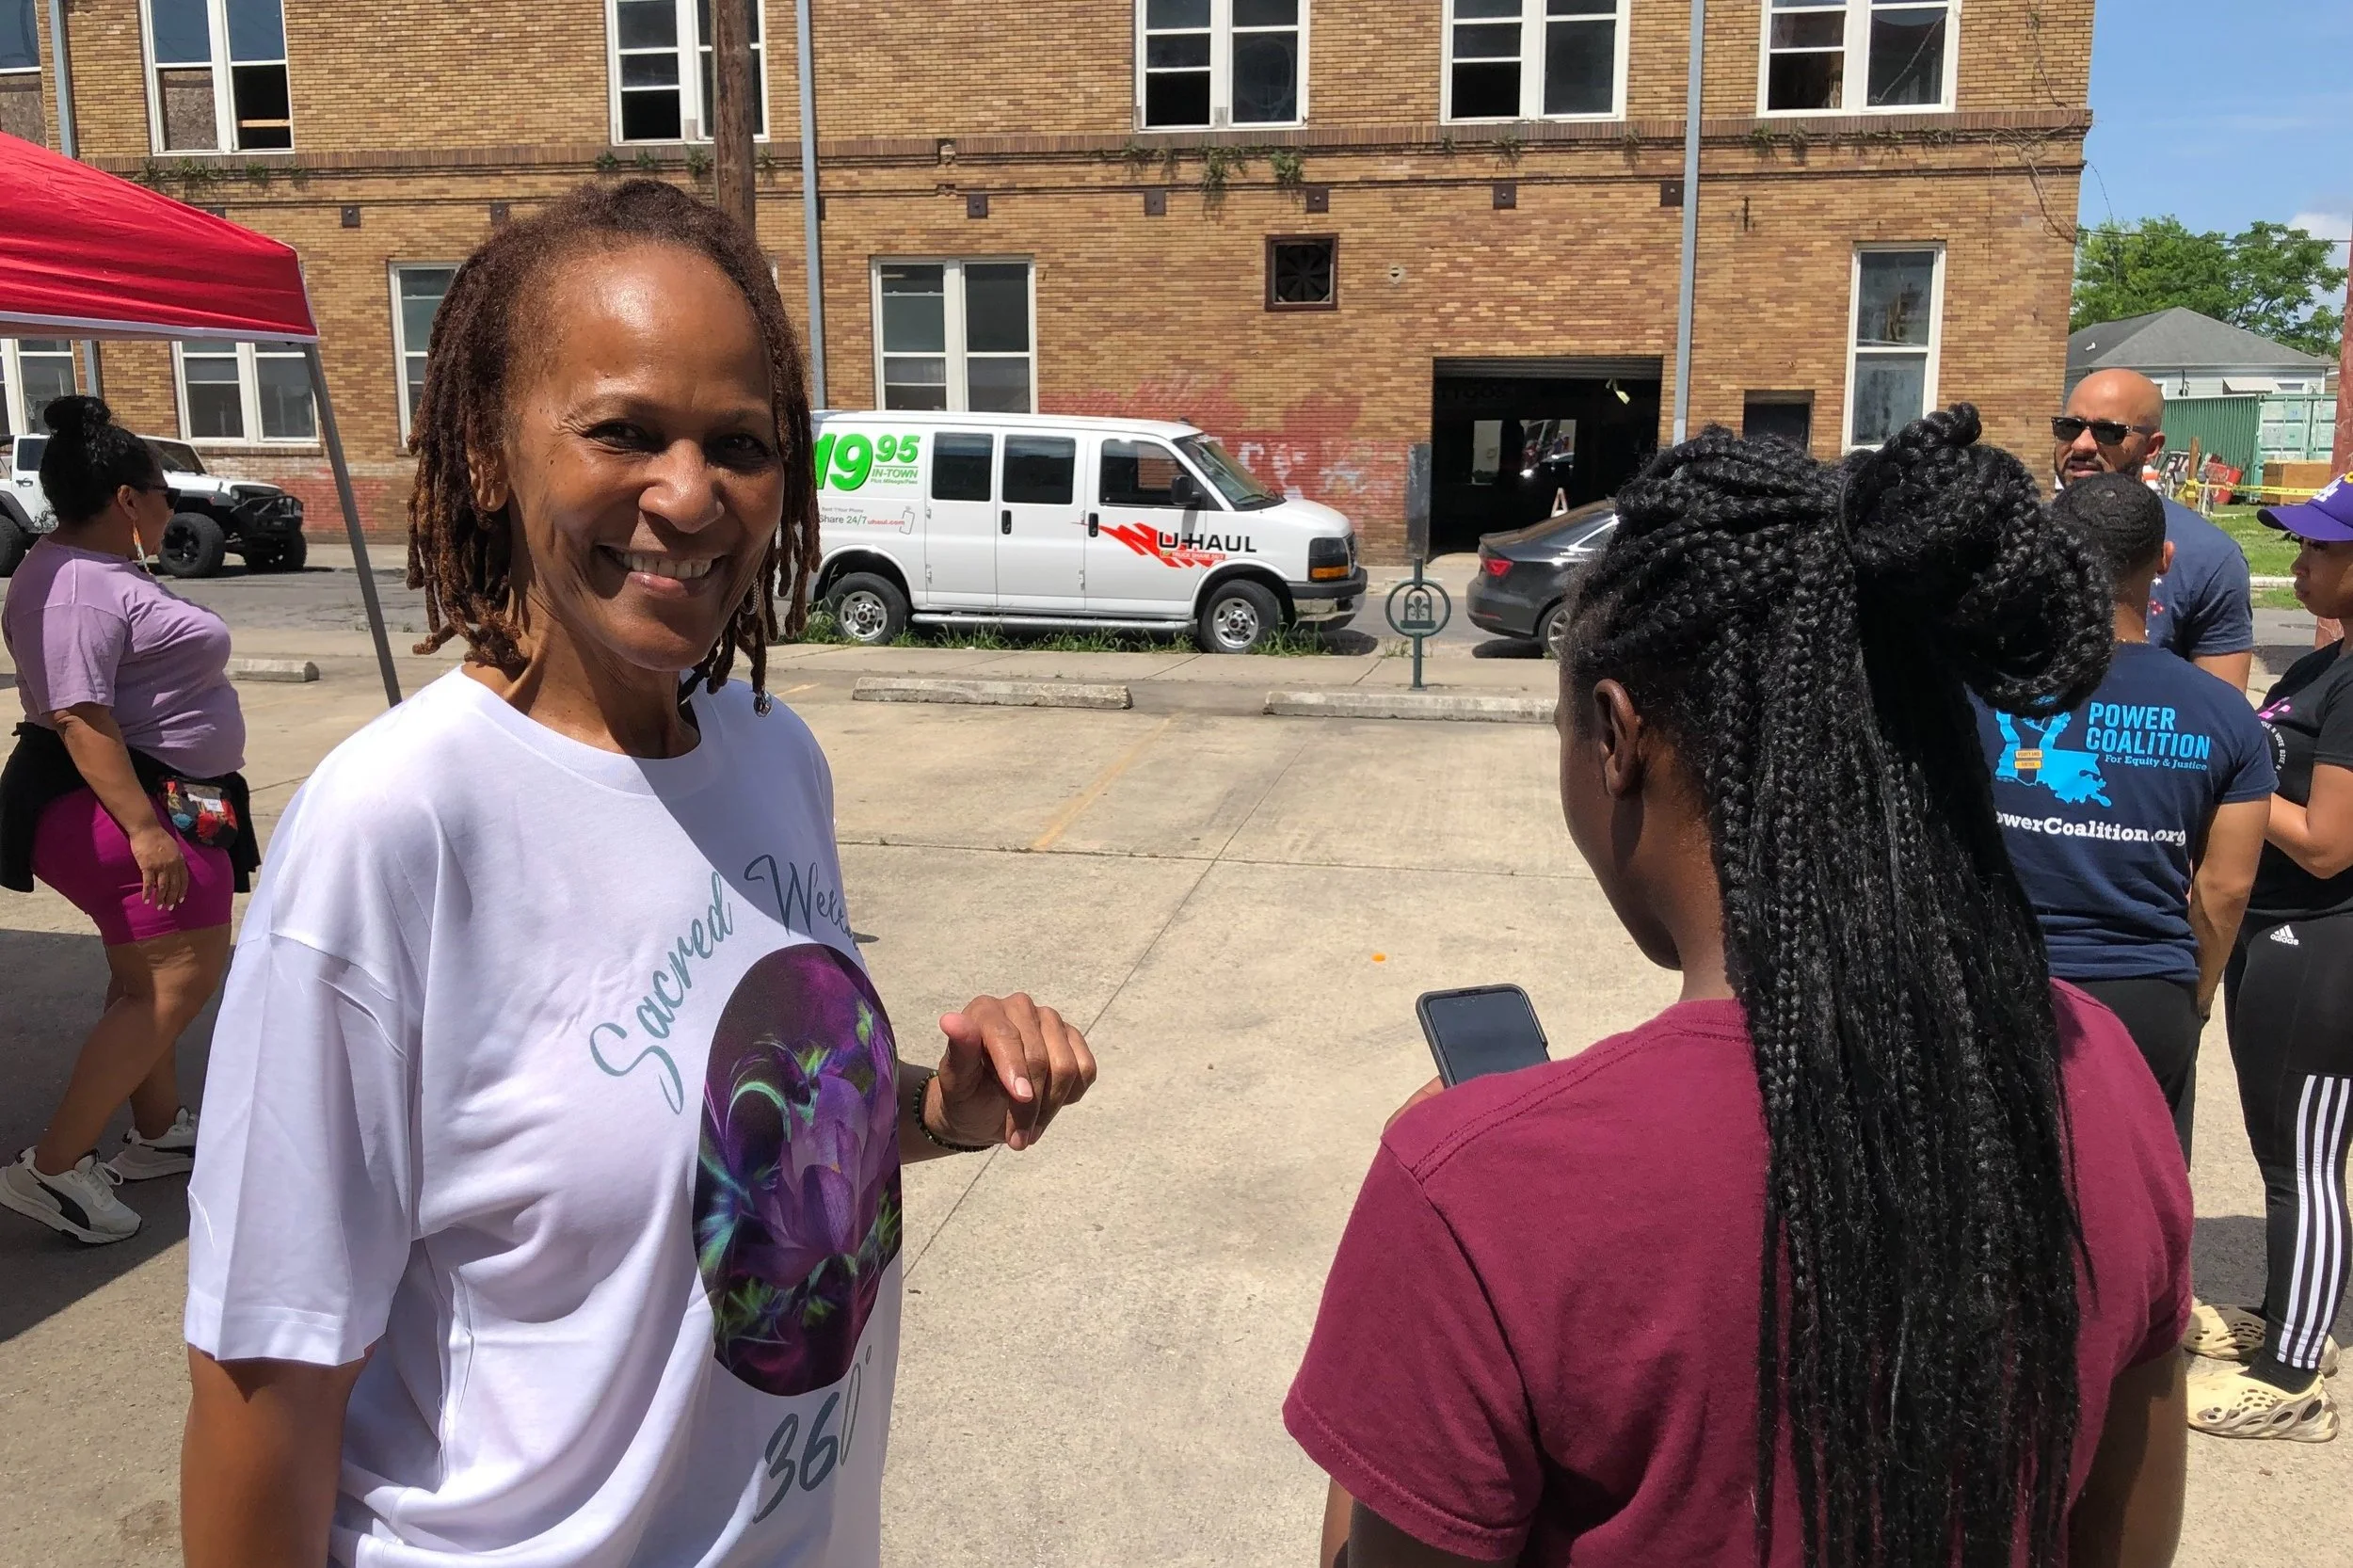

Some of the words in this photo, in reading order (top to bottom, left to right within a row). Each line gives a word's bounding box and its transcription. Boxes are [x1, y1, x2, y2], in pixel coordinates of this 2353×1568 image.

[872, 469, 919, 478] IN-TOWN
[819, 515, 844, 523] Share
[846, 515, 868, 525] 24/7
[2089, 702, 2176, 730] POWER
[2086, 727, 2210, 760] COALITION
[2275, 732, 2285, 747] VOTE
[2105, 754, 2122, 763] For
[2124, 755, 2160, 768] Equity
[2162, 759, 2171, 767] &
[2171, 759, 2207, 771] Justice
[2278, 749, 2286, 764] BIKE
[1996, 810, 2186, 847] owerCoalition.org
[2269, 933, 2299, 946] adidas
[589, 871, 733, 1114] Sacred
